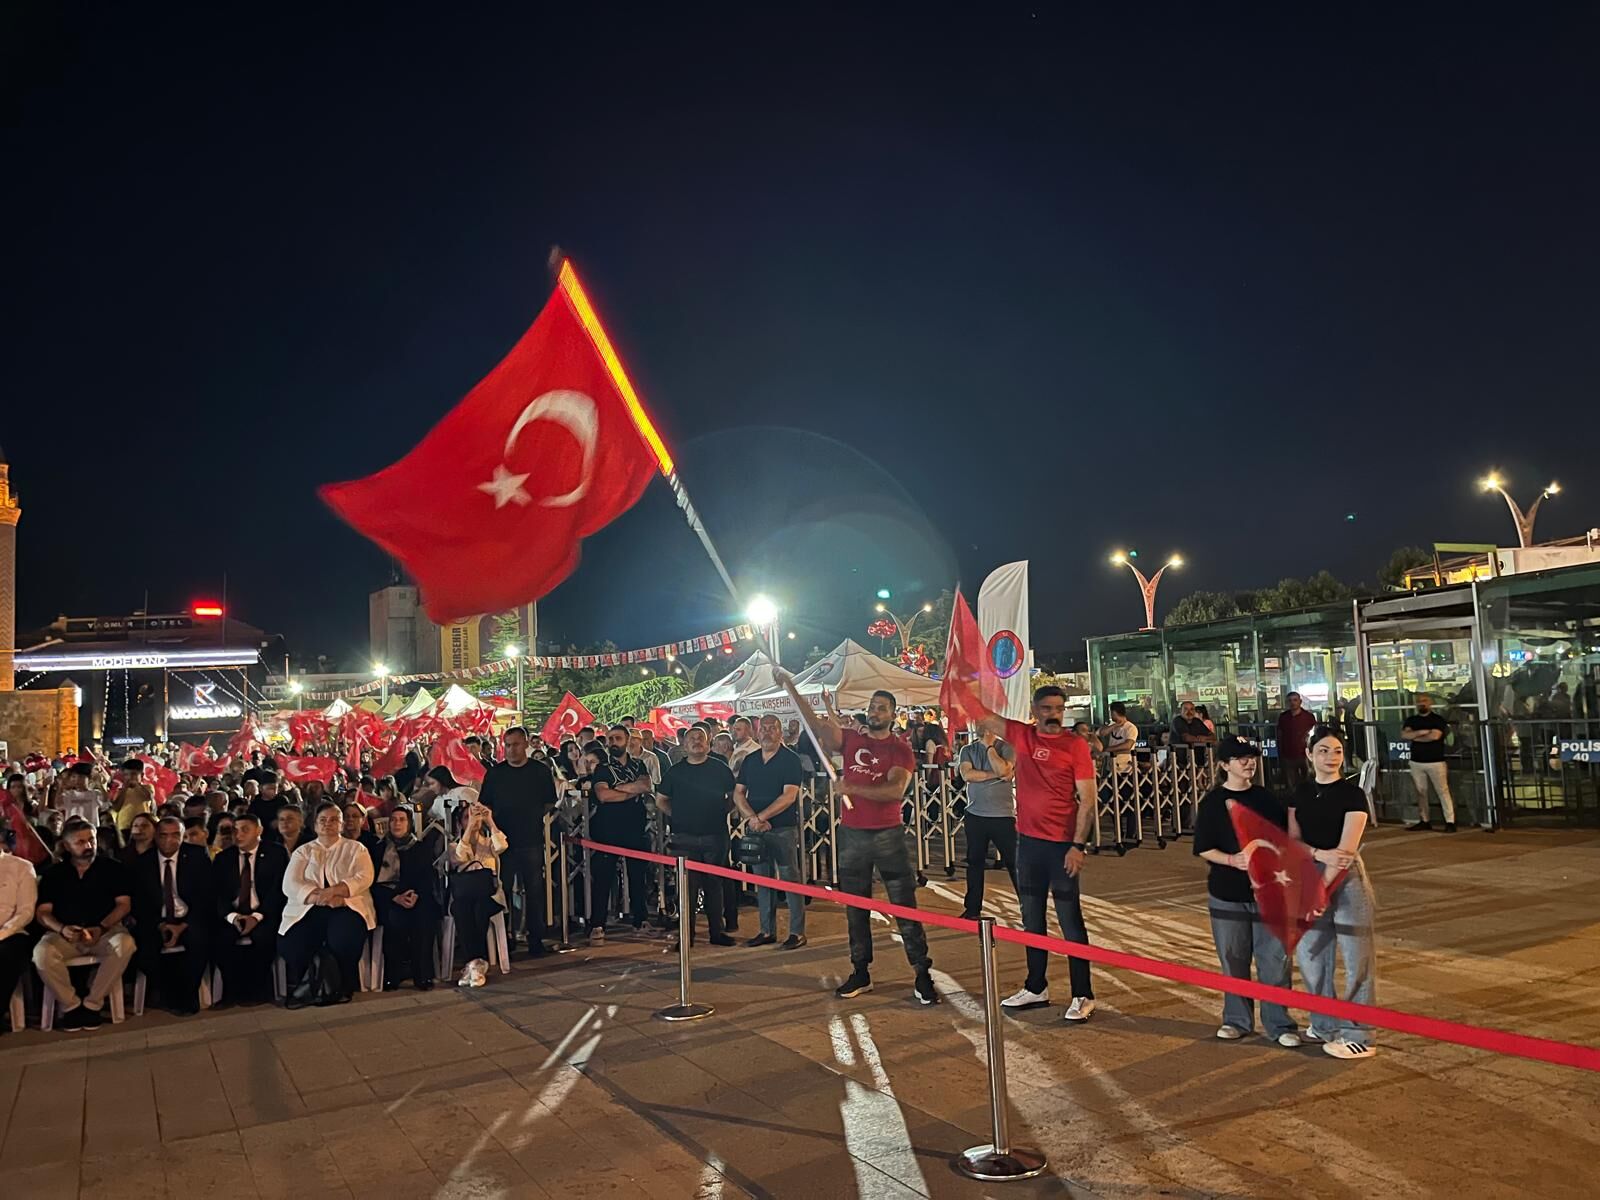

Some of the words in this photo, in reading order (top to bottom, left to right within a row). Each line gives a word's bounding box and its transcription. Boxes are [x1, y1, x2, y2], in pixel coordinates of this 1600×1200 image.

[92, 655, 168, 668] MODELAND
[1249, 738, 1277, 748] PLİS
[1389, 742, 1411, 751] POL
[1561, 740, 1600, 752] POLİS
[1572, 752, 1590, 762] 40
